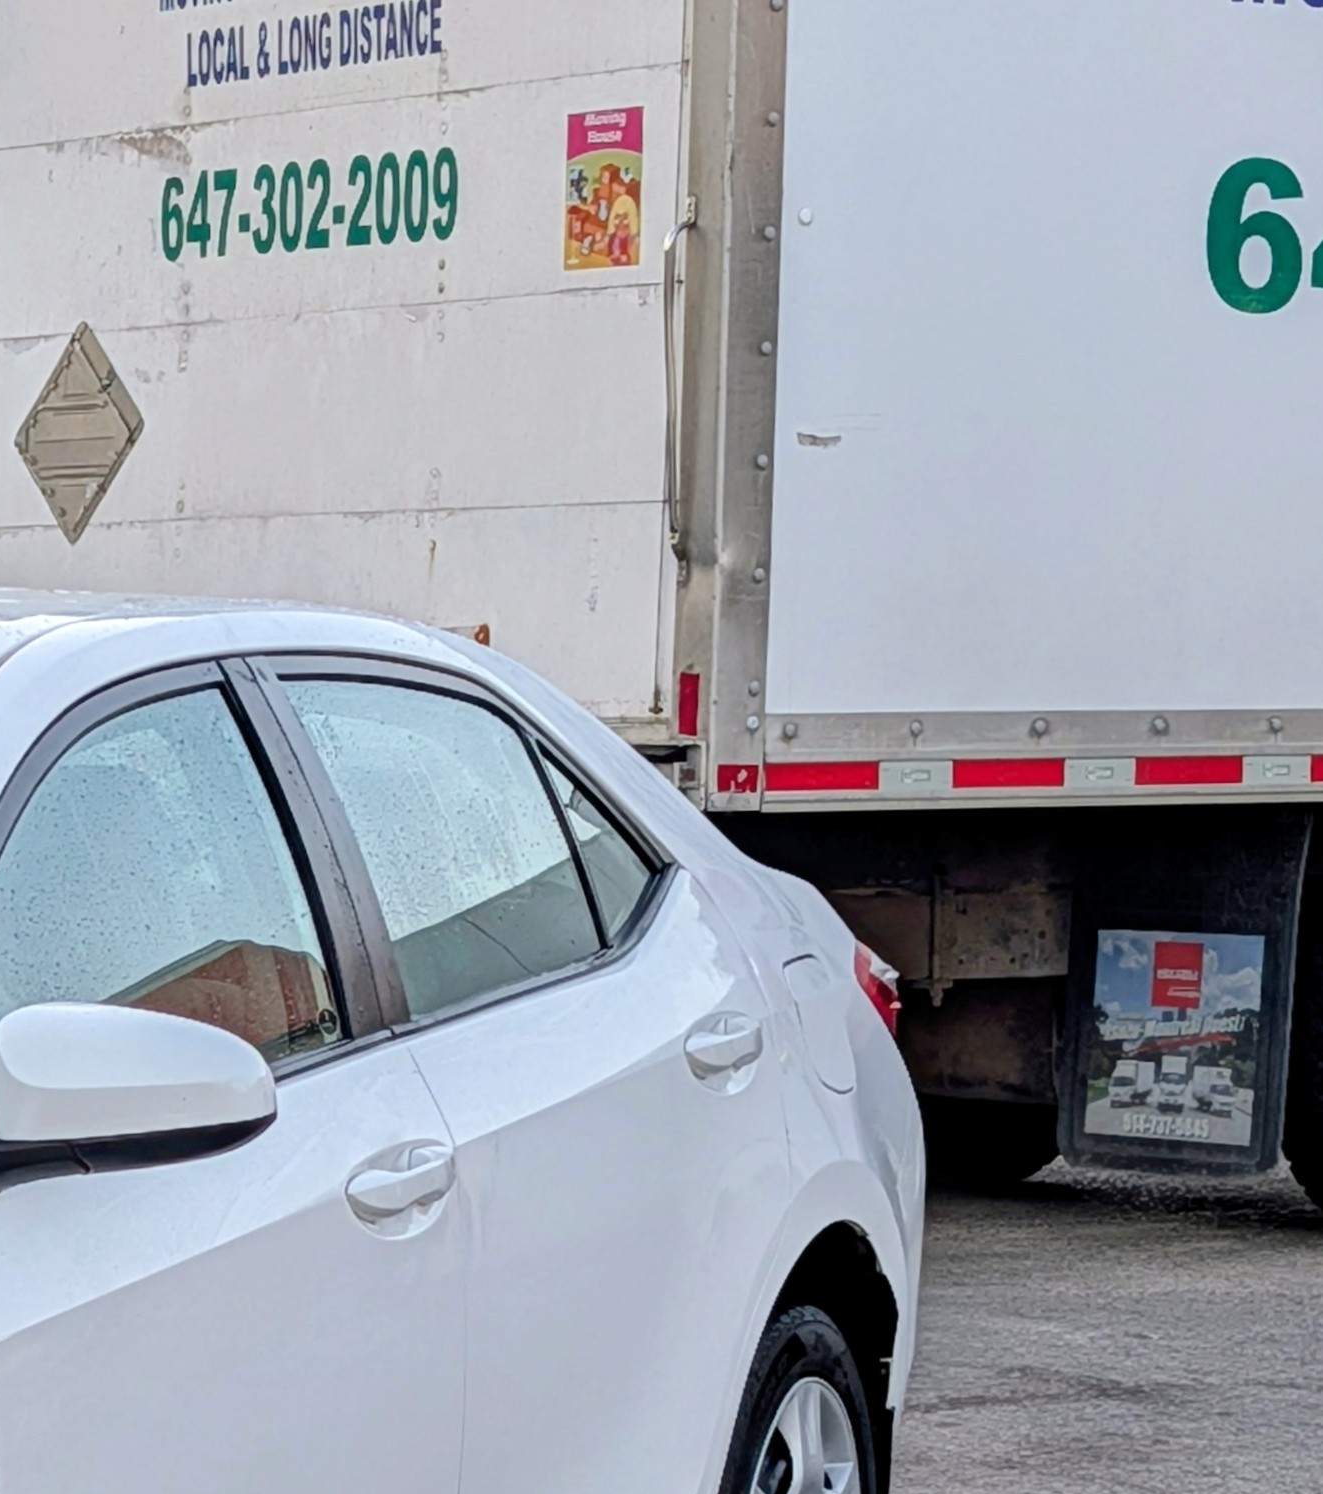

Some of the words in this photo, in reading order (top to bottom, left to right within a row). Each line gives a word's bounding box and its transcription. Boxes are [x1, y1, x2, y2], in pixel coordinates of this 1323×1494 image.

[186, 25, 250, 87] LOCAL
[257, 21, 271, 79] &
[278, 12, 332, 75] LONG
[339, 0, 443, 66] DISTANCE
[161, 146, 459, 262] 647-302-2009
[1206, 156, 1323, 314] 6
